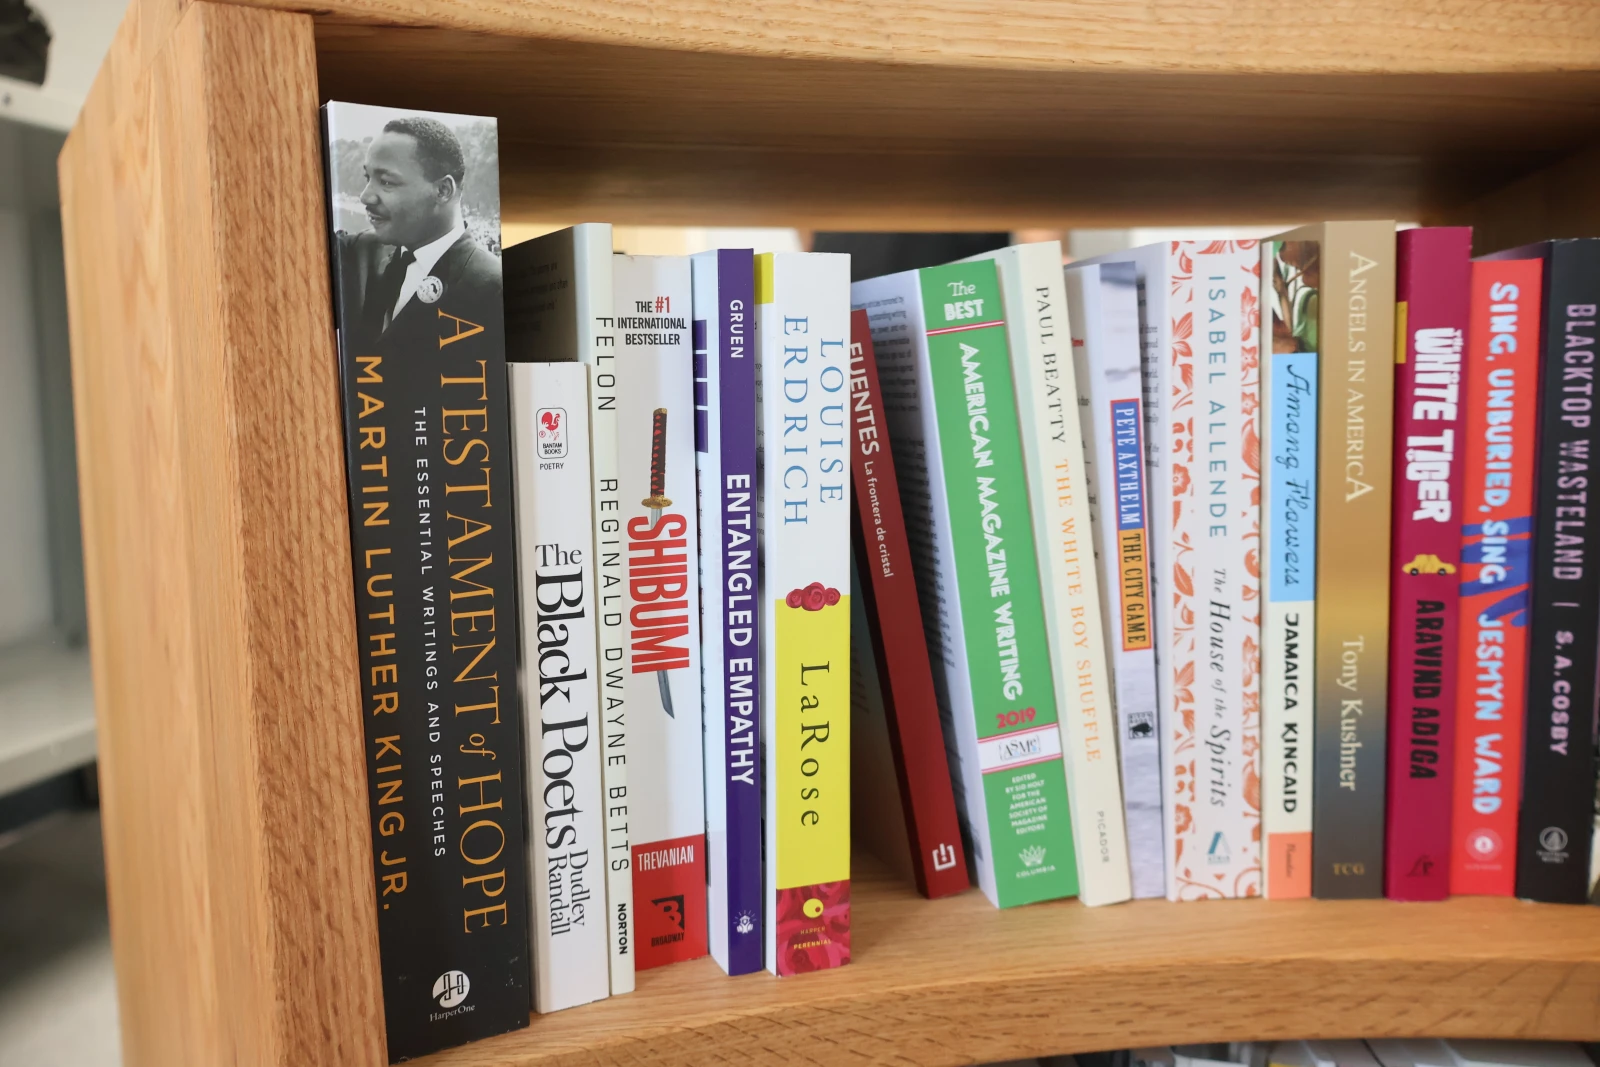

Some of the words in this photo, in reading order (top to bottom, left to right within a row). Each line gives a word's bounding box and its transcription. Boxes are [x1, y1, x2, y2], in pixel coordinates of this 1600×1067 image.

[617, 316, 688, 330] INTERNATIONAL
[635, 300, 653, 313] THE
[655, 296, 671, 314] #1
[943, 299, 984, 321] BEST
[947, 280, 977, 298] The
[1035, 286, 1055, 345] PAUL
[1348, 251, 1379, 354] ANGELS
[1485, 281, 1520, 362] SING,
[437, 307, 485, 351] A
[596, 317, 616, 411] FELON
[625, 333, 681, 346] BESTSELLER
[729, 299, 744, 359] GRUEN
[1208, 275, 1227, 385] ISABEL
[1560, 303, 1597, 429] BLACKTOP
[958, 342, 995, 469] AMERICAN
[1043, 353, 1066, 444] BEATTY
[1347, 359, 1366, 382] IN
[1412, 327, 1462, 421] WHITE
[355, 356, 390, 527] MARTIN
[413, 406, 427, 446] THE
[783, 315, 809, 526] ERDRICH
[819, 337, 844, 503] LOUISE
[1115, 407, 1136, 447] PETE
[1274, 363, 1312, 470] Among
[1345, 388, 1375, 503] AMERICA
[1477, 368, 1515, 514] UNBURIED,
[539, 462, 564, 471] POETRY
[864, 460, 873, 476] La
[867, 477, 882, 526] frontera
[1054, 458, 1073, 508] THE
[1117, 451, 1141, 525] AXTHELM
[1208, 399, 1228, 538] ALLENDE
[1405, 428, 1455, 523] TIGER
[416, 458, 433, 575] ESSENTIAL
[440, 359, 502, 726] TESTAMENT
[875, 526, 885, 542] de
[976, 475, 1011, 599] MAGAZINE
[1284, 477, 1311, 588] Flowers
[1552, 440, 1591, 580] WASTELAND
[535, 543, 583, 568] The
[599, 478, 622, 628] REGINALD
[727, 474, 753, 647] ENTANGLED
[879, 542, 894, 578] cristal
[1061, 516, 1083, 597] WHITE
[1122, 533, 1142, 564] THE
[1124, 567, 1144, 600] CITY
[1212, 567, 1227, 594] The
[1479, 519, 1510, 585] SING
[627, 513, 690, 674] SHIBUMI
[1070, 604, 1089, 650] BOY
[1126, 602, 1147, 644] GAME
[365, 548, 398, 717] LUTHER
[422, 586, 439, 691] WRITINGS
[535, 566, 588, 710] Black
[992, 600, 1024, 702] WRITING
[1209, 598, 1231, 673] House
[1284, 612, 1300, 711] JAMAICA
[1336, 635, 1365, 692] Tony
[1412, 599, 1446, 700] ARAVIND
[1474, 612, 1505, 721] JESMYN
[426, 701, 440, 743] AND
[605, 647, 626, 767] DWAYNE
[729, 656, 755, 786] EMPATHY
[995, 706, 1037, 729] 2019
[1076, 658, 1102, 763] SHUFFLE
[1210, 678, 1228, 694] of
[1212, 695, 1228, 720] the
[459, 732, 496, 760] of
[800, 660, 830, 827] LaRose
[1012, 772, 1037, 783] EDITED
[1205, 724, 1232, 808] Spirits
[1282, 722, 1300, 814] KINCAID
[1339, 698, 1363, 791] Kushner
[1409, 706, 1441, 780] ADIGA
[1472, 732, 1503, 815] WARD
[374, 735, 406, 838] KING
[429, 754, 446, 857] SPEECHES
[541, 712, 589, 850] Poets
[1005, 786, 1014, 794] BY
[1009, 808, 1037, 820] SOCIETY
[1038, 804, 1048, 814] OF
[1010, 797, 1047, 811] AMERICAN
[1012, 793, 1027, 801] FOR
[1027, 789, 1041, 798] THE
[457, 769, 508, 935] HOPE
[609, 785, 630, 872] BETTS
[1011, 814, 1048, 827] MAGAZINE
[1015, 823, 1046, 835] EDITORS
[1097, 810, 1111, 864] PICADOR
[380, 851, 408, 911] JR.
[548, 853, 571, 937] Randall
[567, 849, 591, 927] Dudley
[637, 845, 695, 872] TREVANIAN
[1016, 864, 1056, 879] COLUMBIA
[1332, 862, 1365, 876] TCG
[617, 903, 628, 955] NORTON
[651, 931, 685, 947] BROADWAY
[793, 938, 832, 950] PERENNIAL
[429, 1004, 477, 1022] HarperOne
